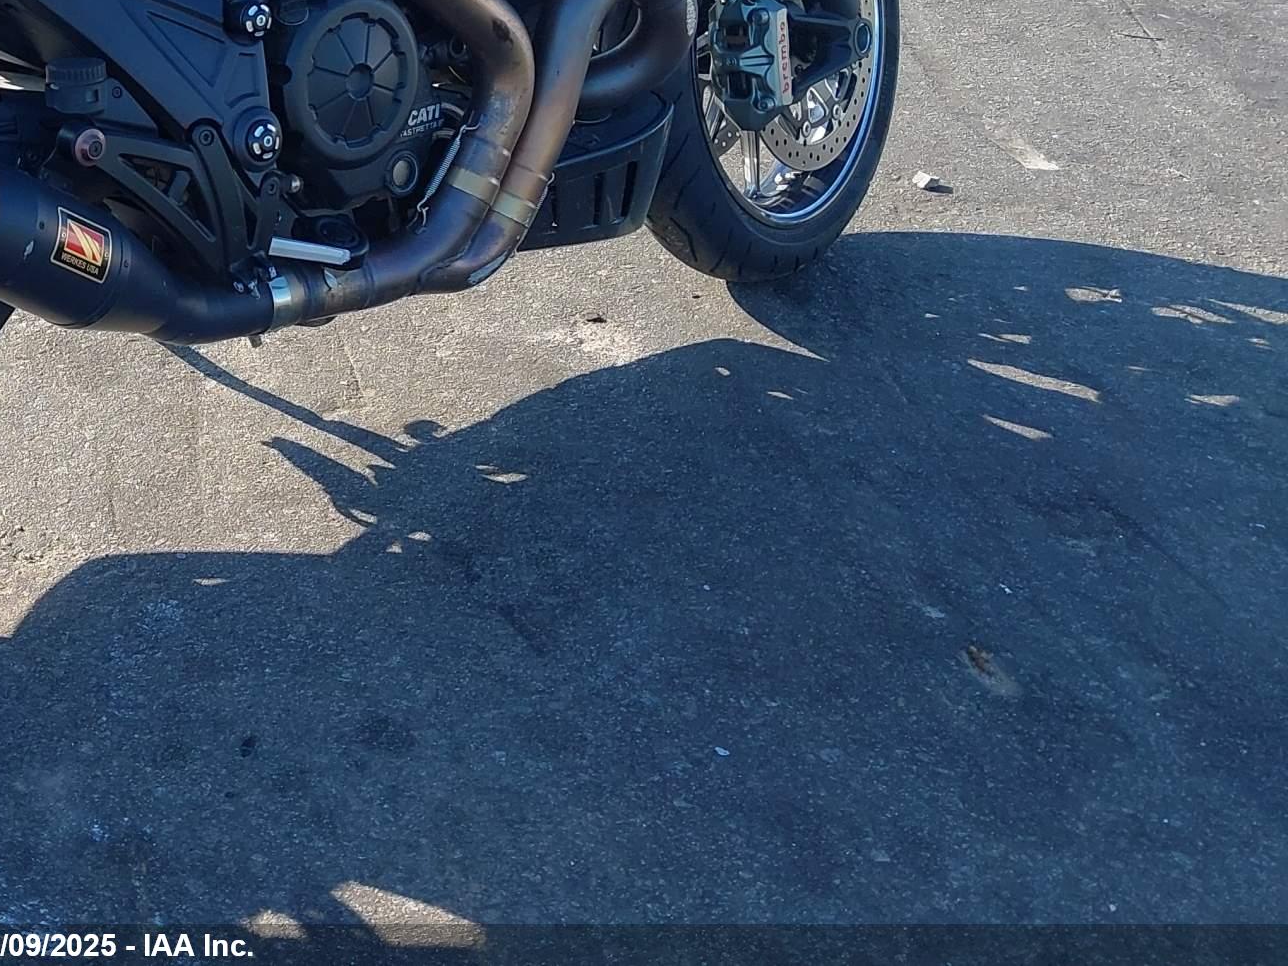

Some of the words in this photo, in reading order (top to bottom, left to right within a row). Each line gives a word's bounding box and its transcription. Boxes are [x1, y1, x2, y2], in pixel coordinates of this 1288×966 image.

[778, 21, 790, 94] brembo
[61, 252, 87, 269] WERKES
[86, 263, 99, 275] USA
